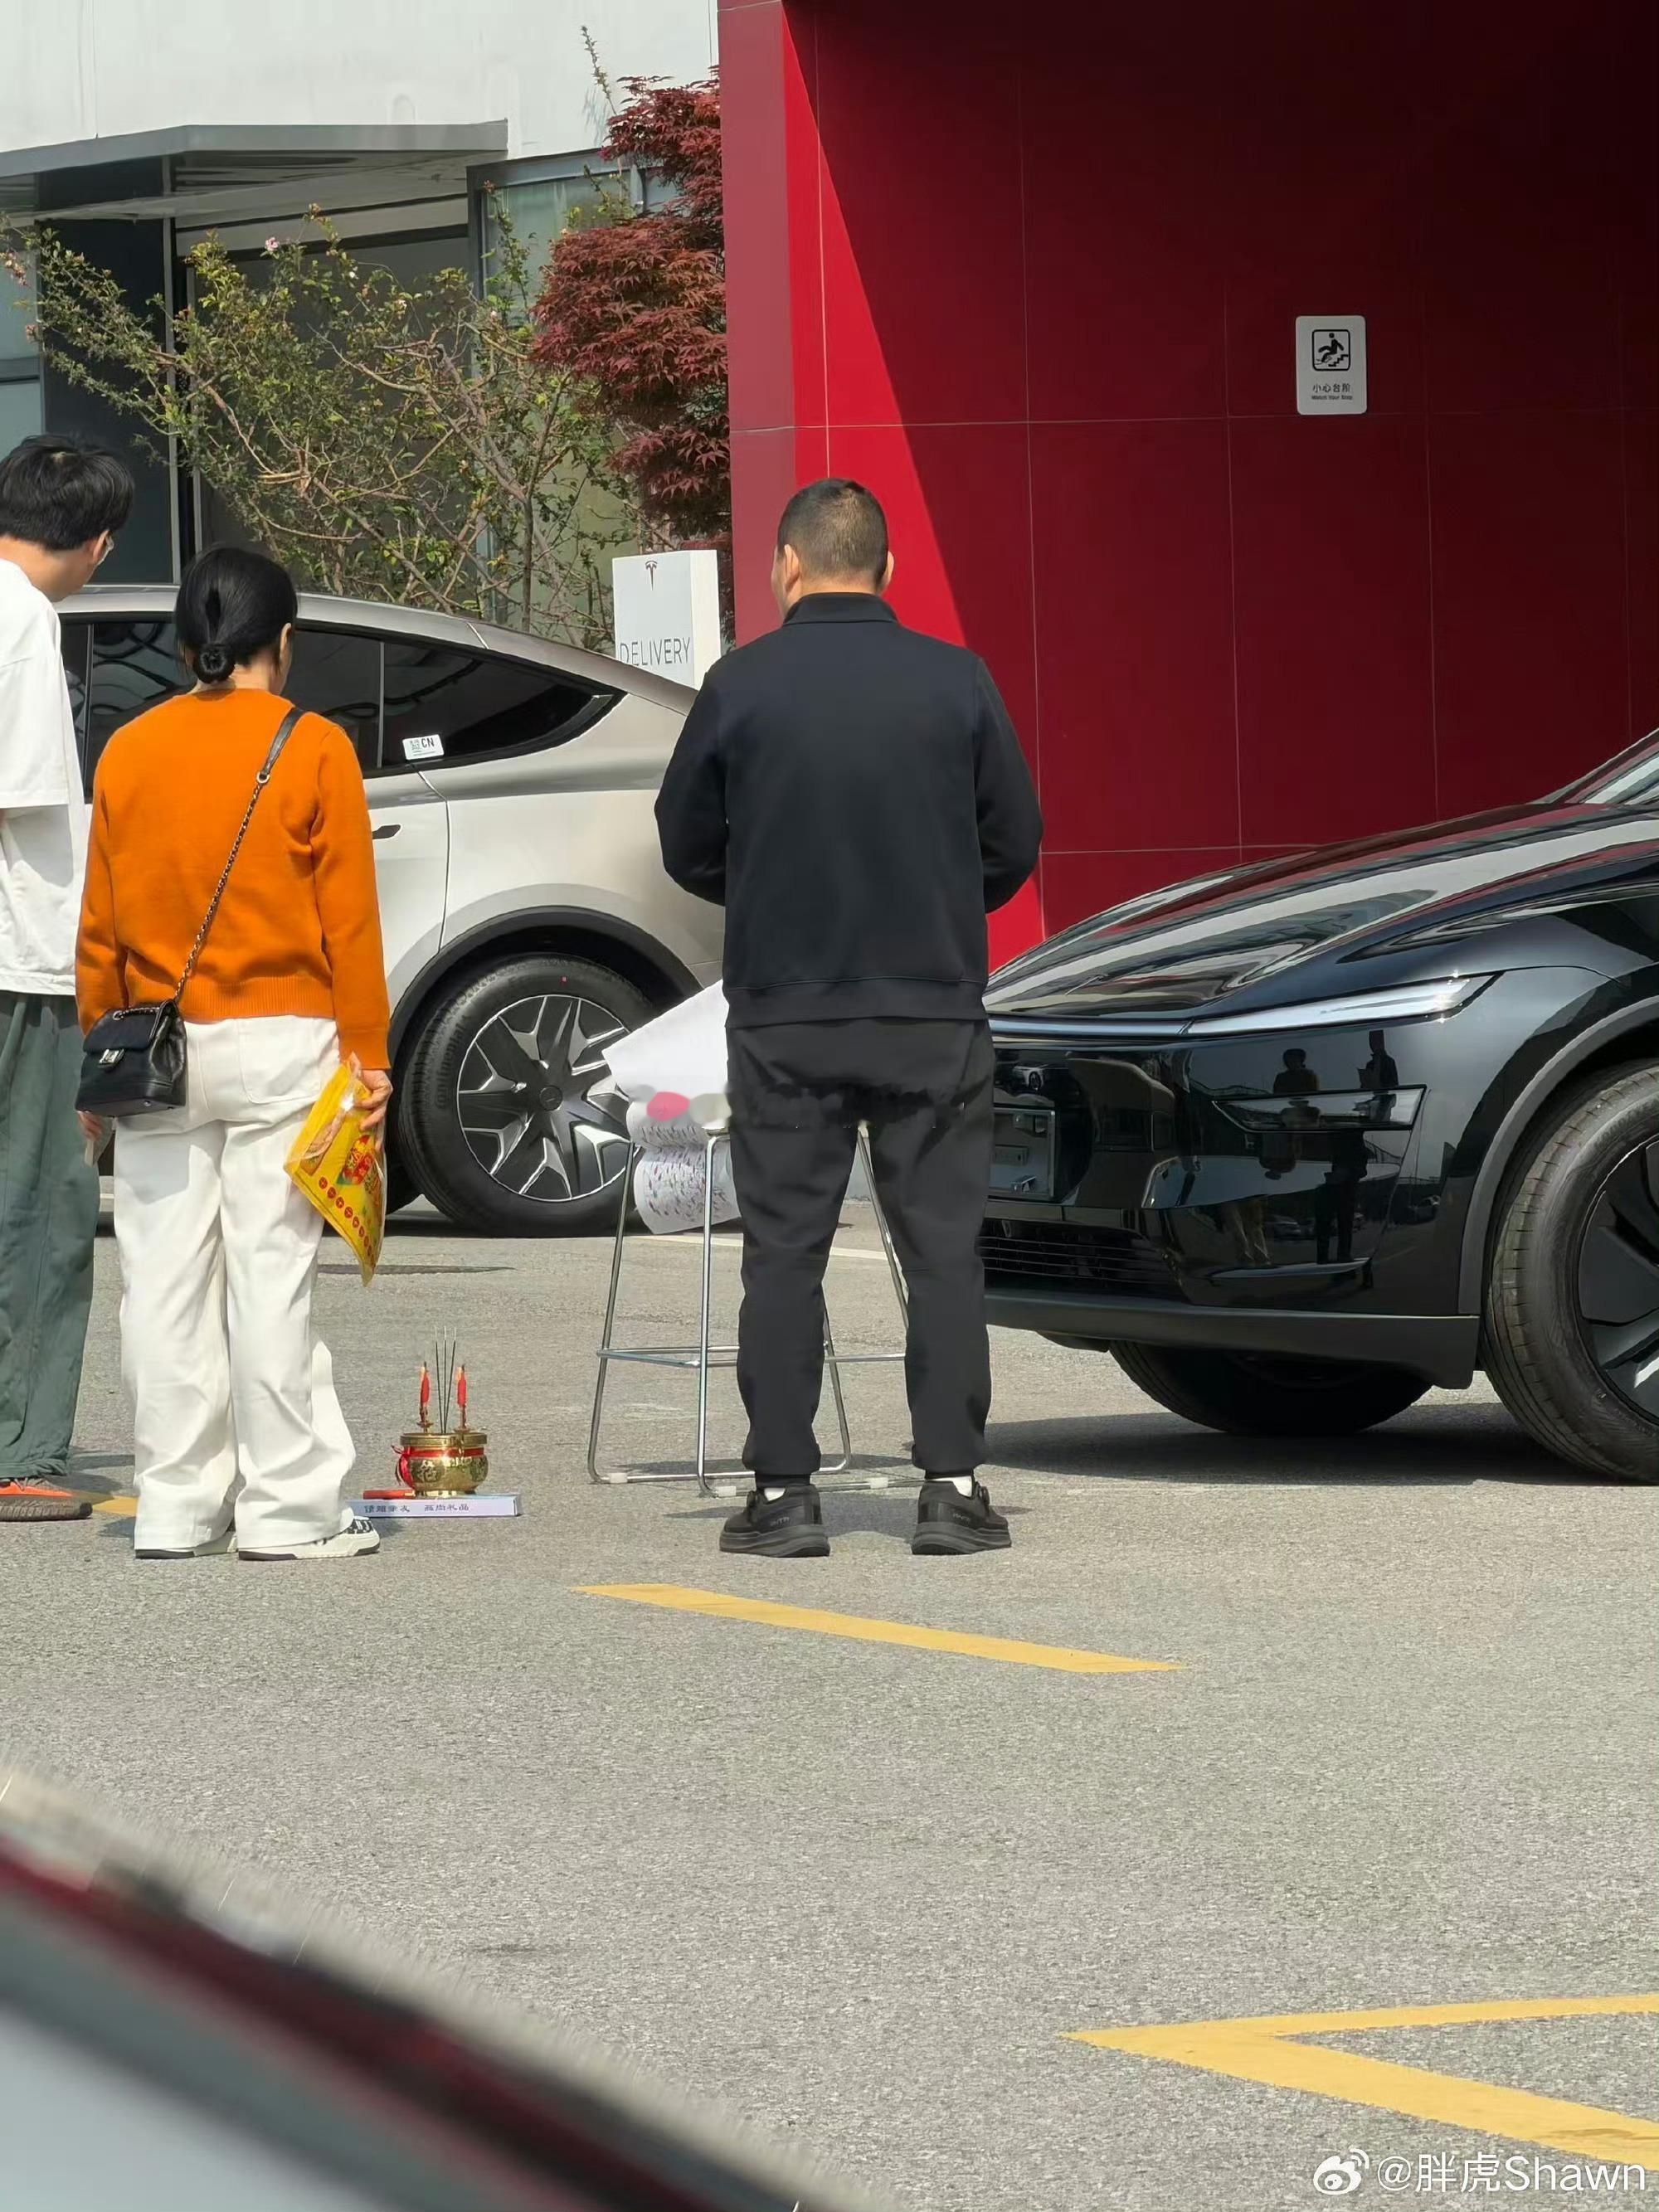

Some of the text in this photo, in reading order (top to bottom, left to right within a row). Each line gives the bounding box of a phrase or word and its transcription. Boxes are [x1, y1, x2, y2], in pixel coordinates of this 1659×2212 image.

[1312, 383, 1351, 393] 小心台阶
[620, 637, 691, 666] DELIVERY
[421, 737, 435, 748] CN
